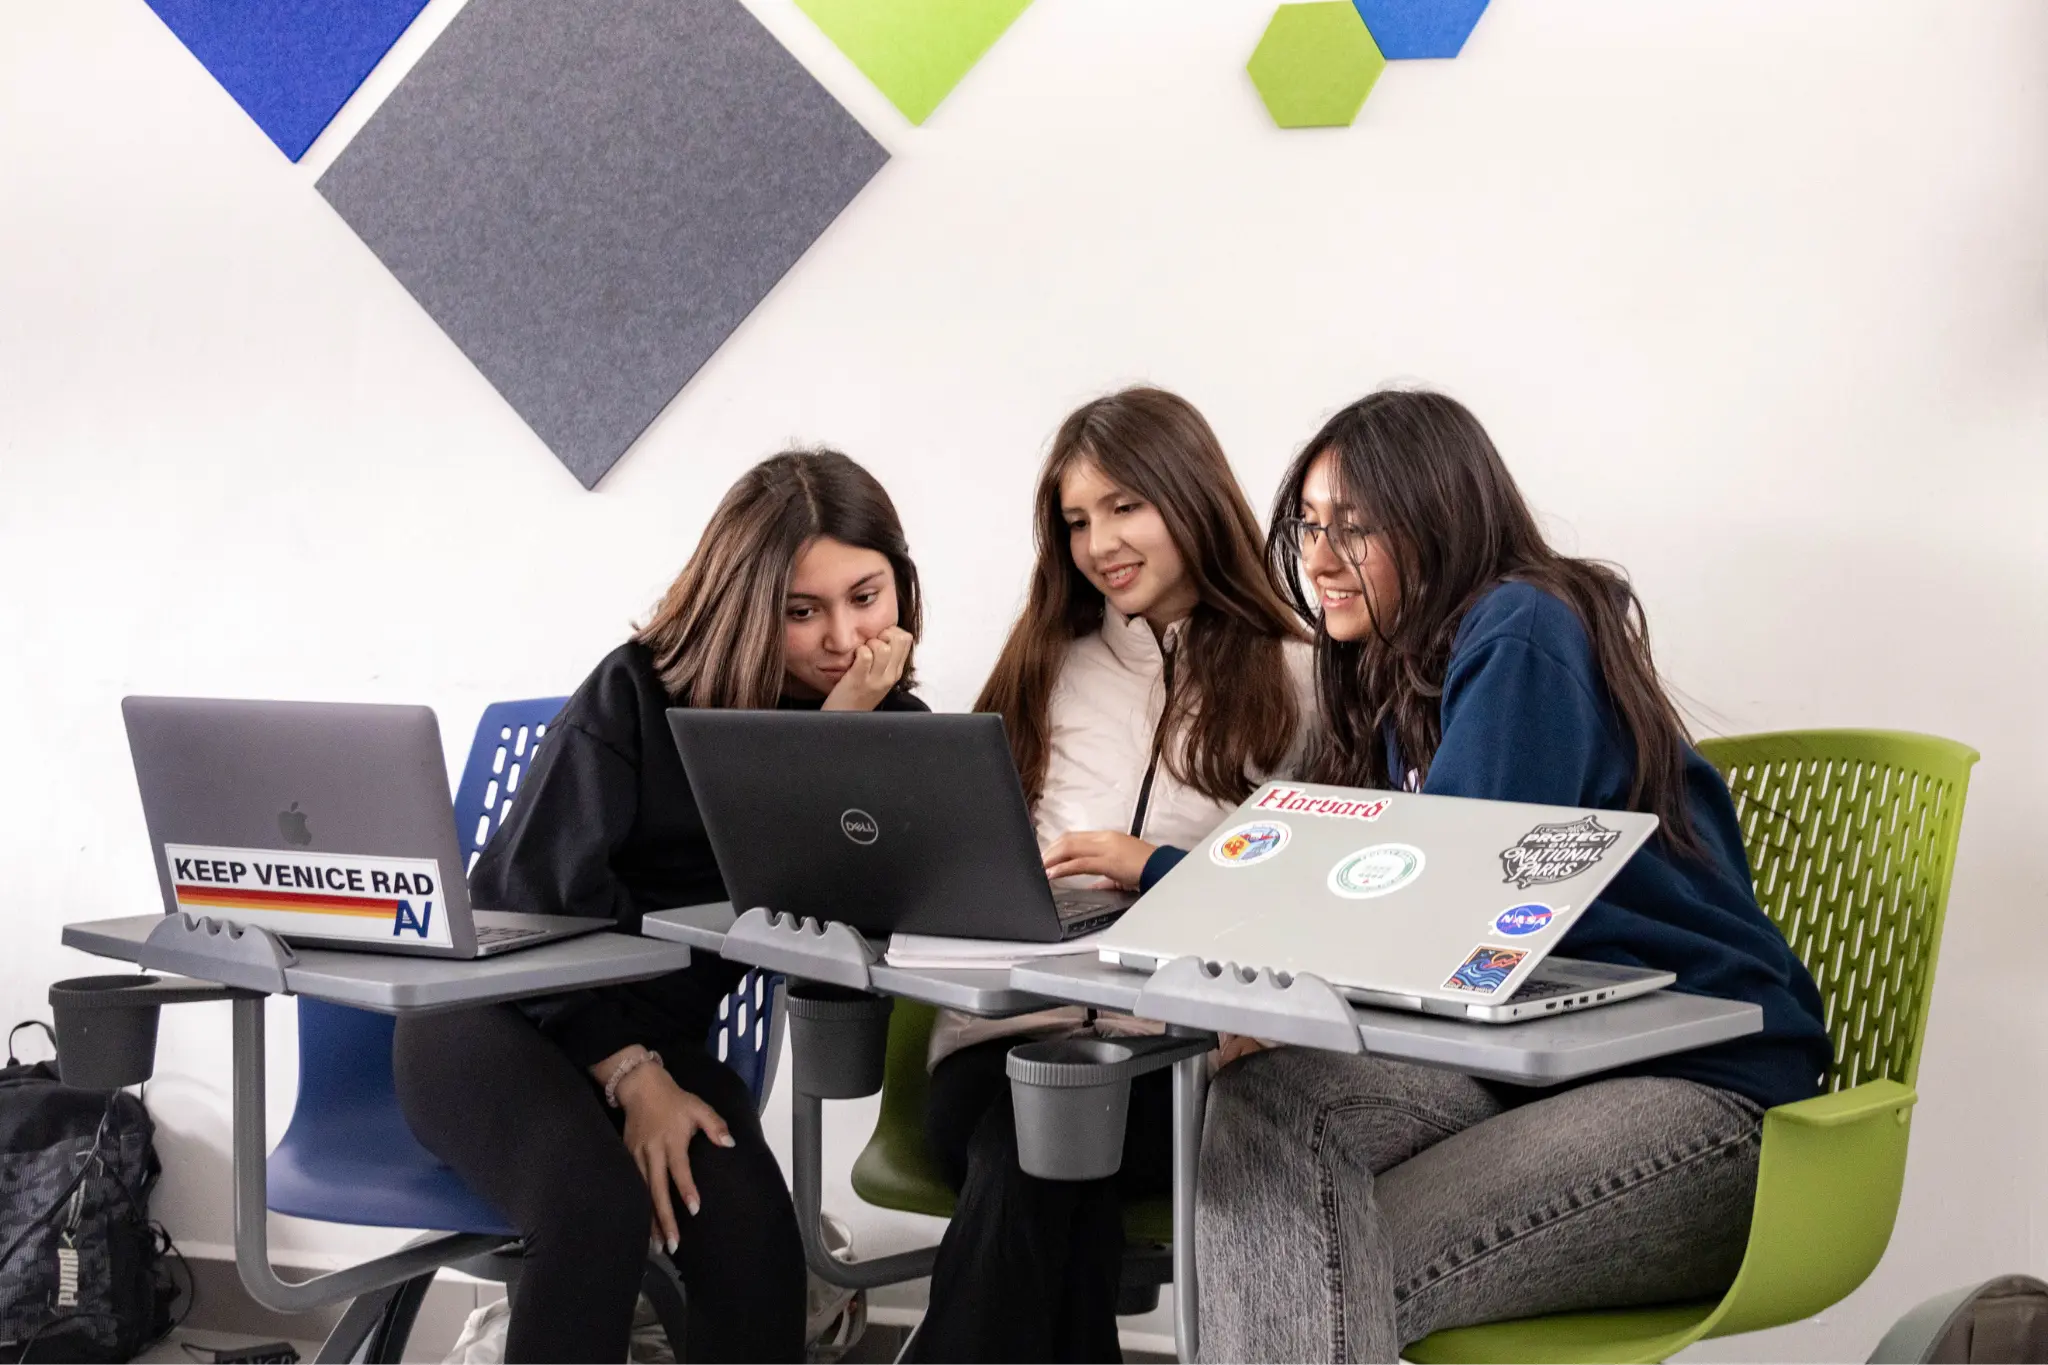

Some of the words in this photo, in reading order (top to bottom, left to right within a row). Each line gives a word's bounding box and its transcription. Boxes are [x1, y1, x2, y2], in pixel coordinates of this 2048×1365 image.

[1258, 788, 1389, 818] Harvard
[845, 821, 875, 832] DELL
[1523, 831, 1618, 843] PROTECT
[1503, 847, 1602, 862] NATIONAL
[174, 858, 247, 883] KEEP
[253, 863, 365, 891] VENICE
[372, 871, 434, 896] RAD
[1511, 860, 1578, 879] PARKS
[1501, 913, 1546, 927] NASA
[58, 1248, 78, 1306] PUMA
